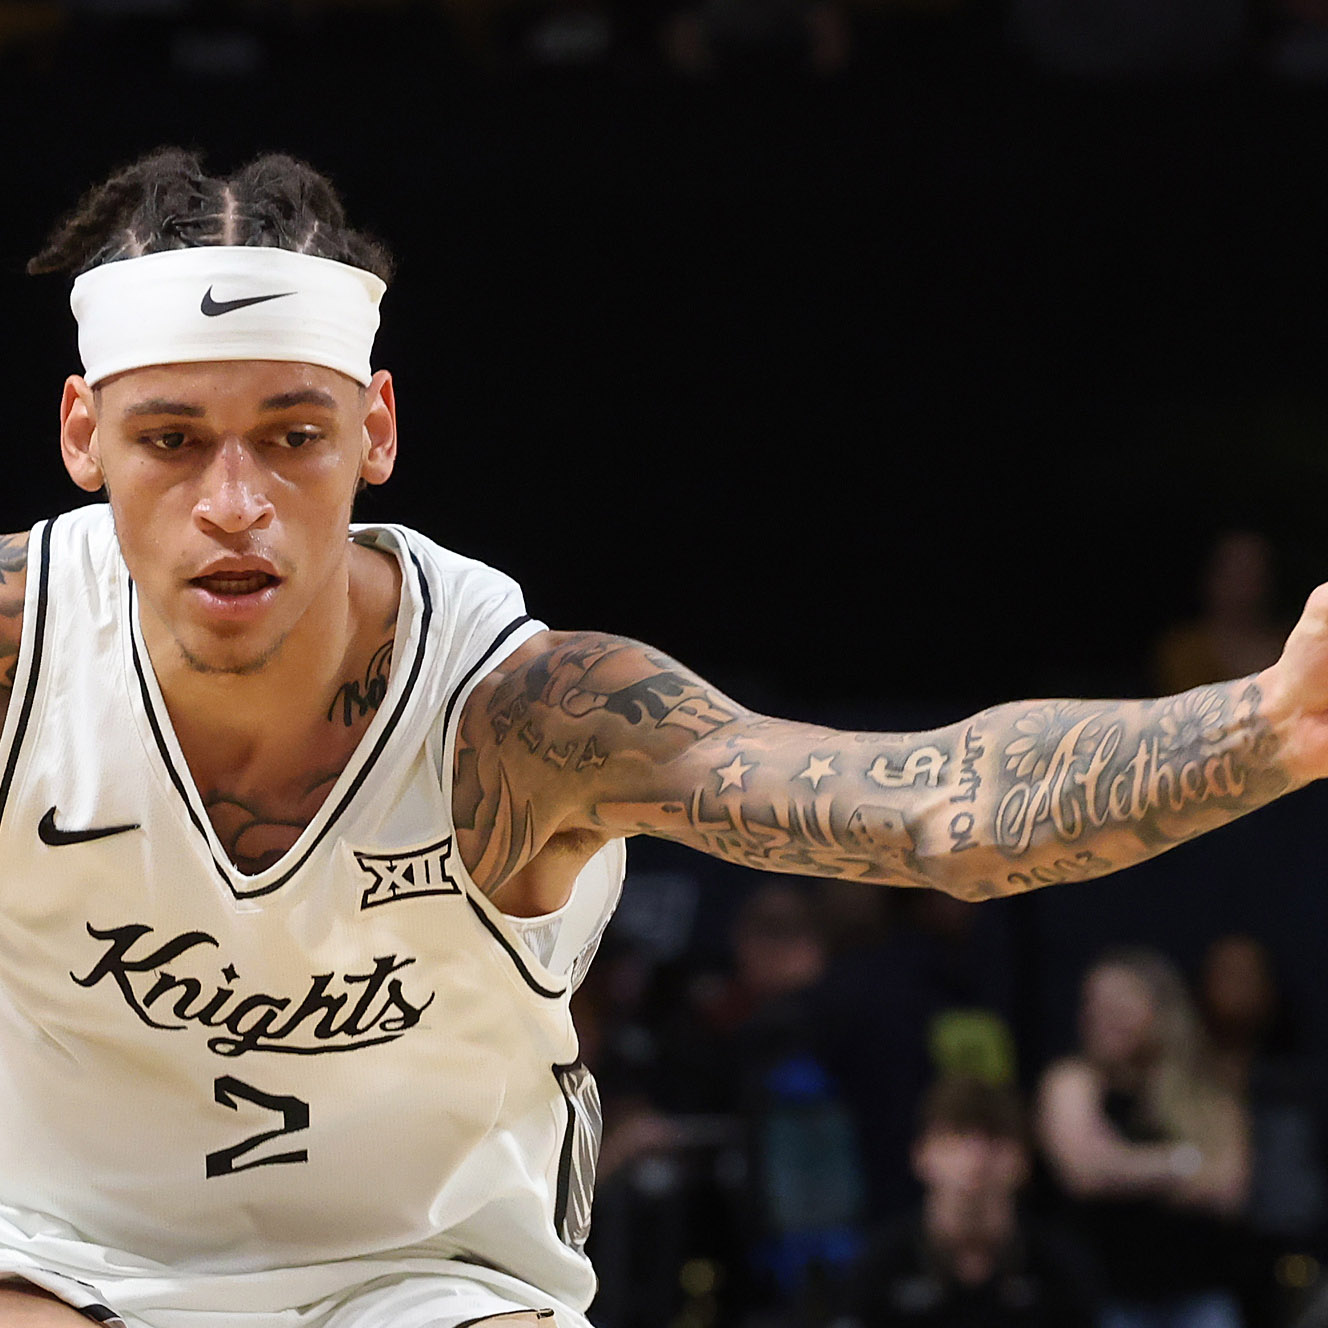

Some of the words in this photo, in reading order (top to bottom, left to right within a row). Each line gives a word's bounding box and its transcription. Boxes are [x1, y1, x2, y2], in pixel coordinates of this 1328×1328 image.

[358, 842, 458, 906] XII
[70, 921, 435, 1057] Knights
[206, 1074, 310, 1180] 2
